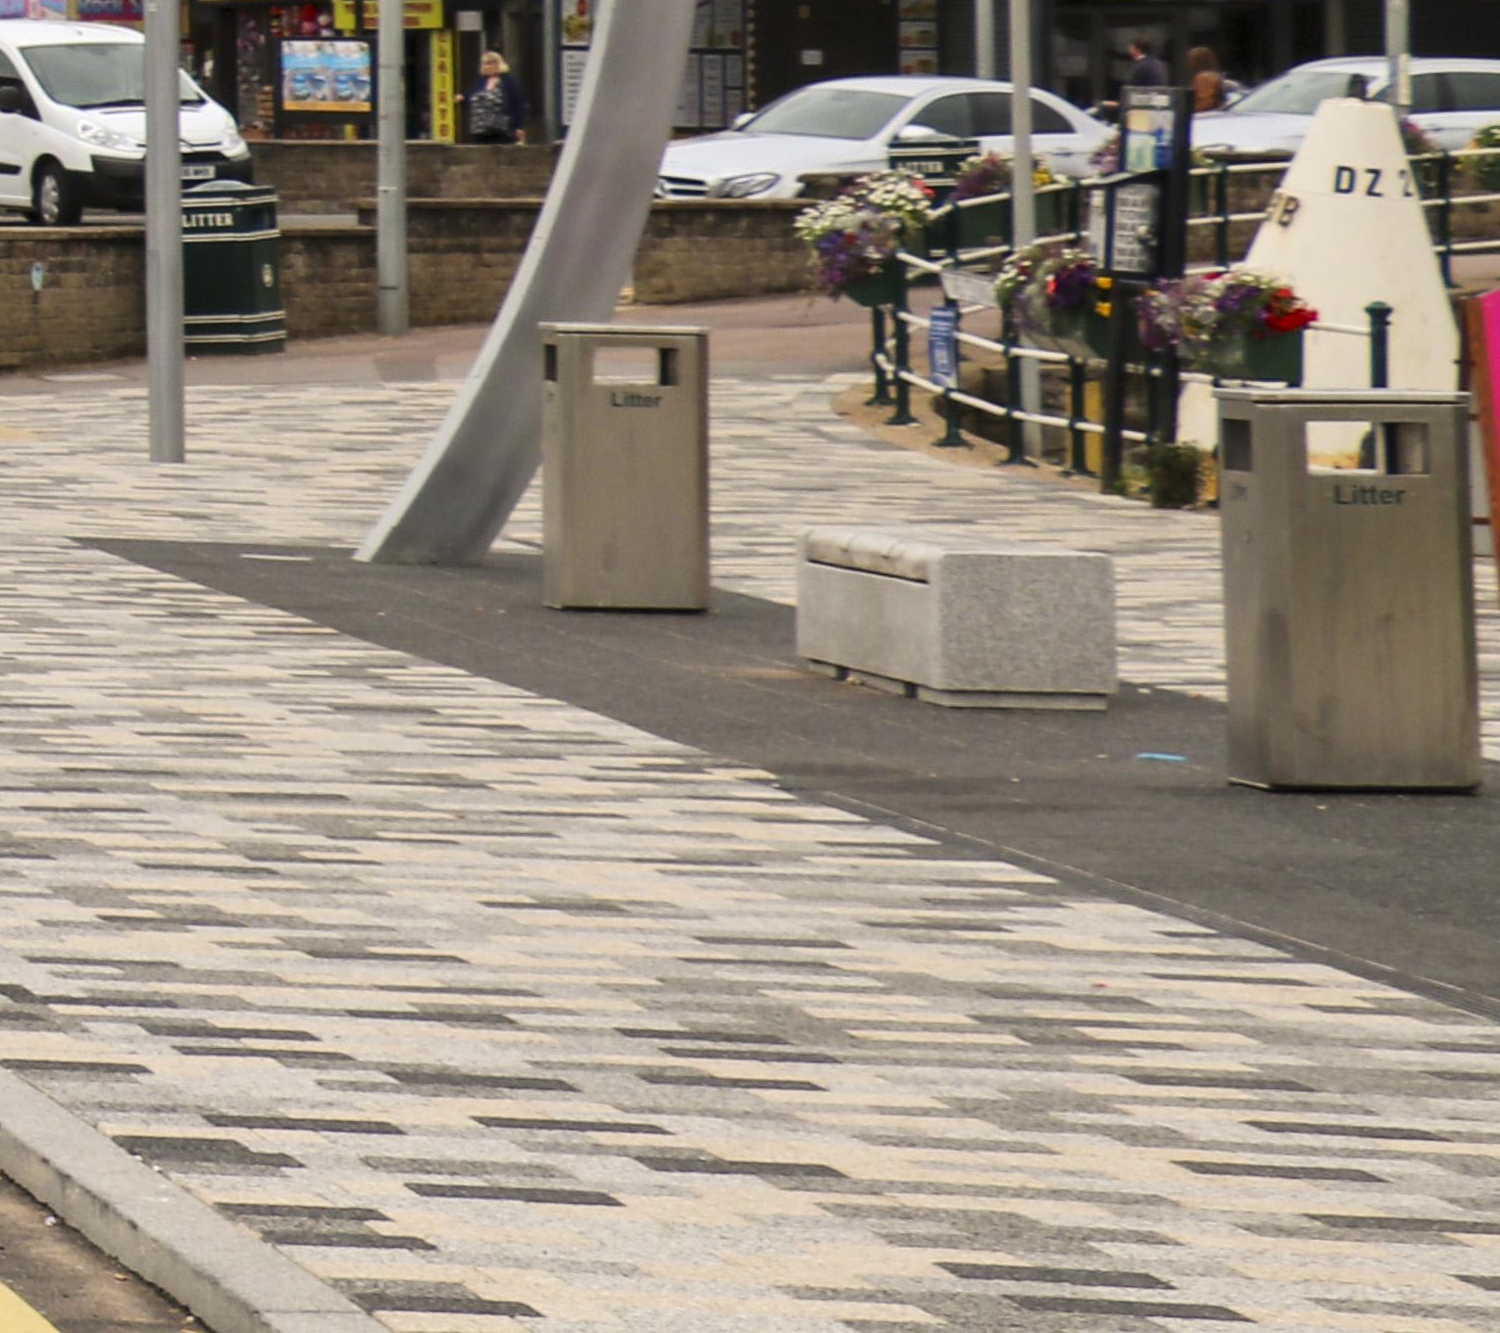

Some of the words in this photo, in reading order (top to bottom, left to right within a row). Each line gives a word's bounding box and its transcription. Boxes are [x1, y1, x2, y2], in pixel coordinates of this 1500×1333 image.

[182, 212, 235, 228] LITTER
[611, 391, 663, 408] Litter
[1333, 484, 1407, 506] Litter
